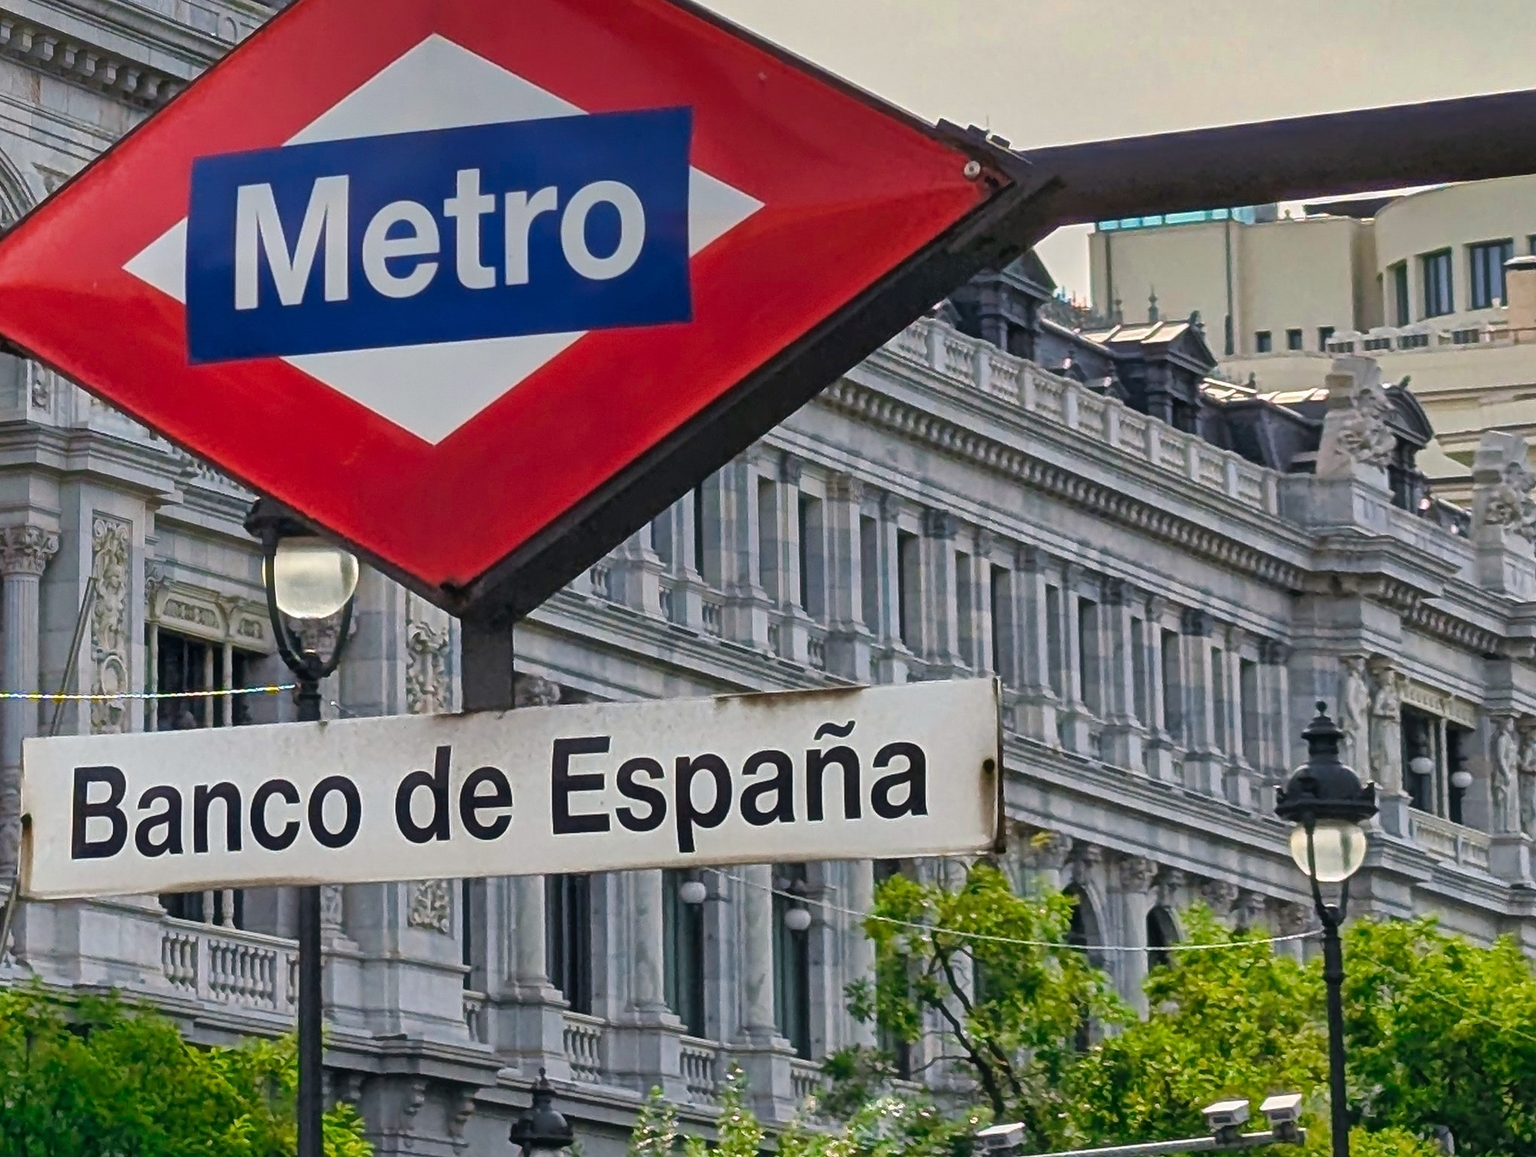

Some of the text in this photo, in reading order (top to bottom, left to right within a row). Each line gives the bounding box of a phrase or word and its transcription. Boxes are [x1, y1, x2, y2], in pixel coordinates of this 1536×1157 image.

[235, 168, 646, 311] Metro
[71, 720, 928, 860] Banco de España
